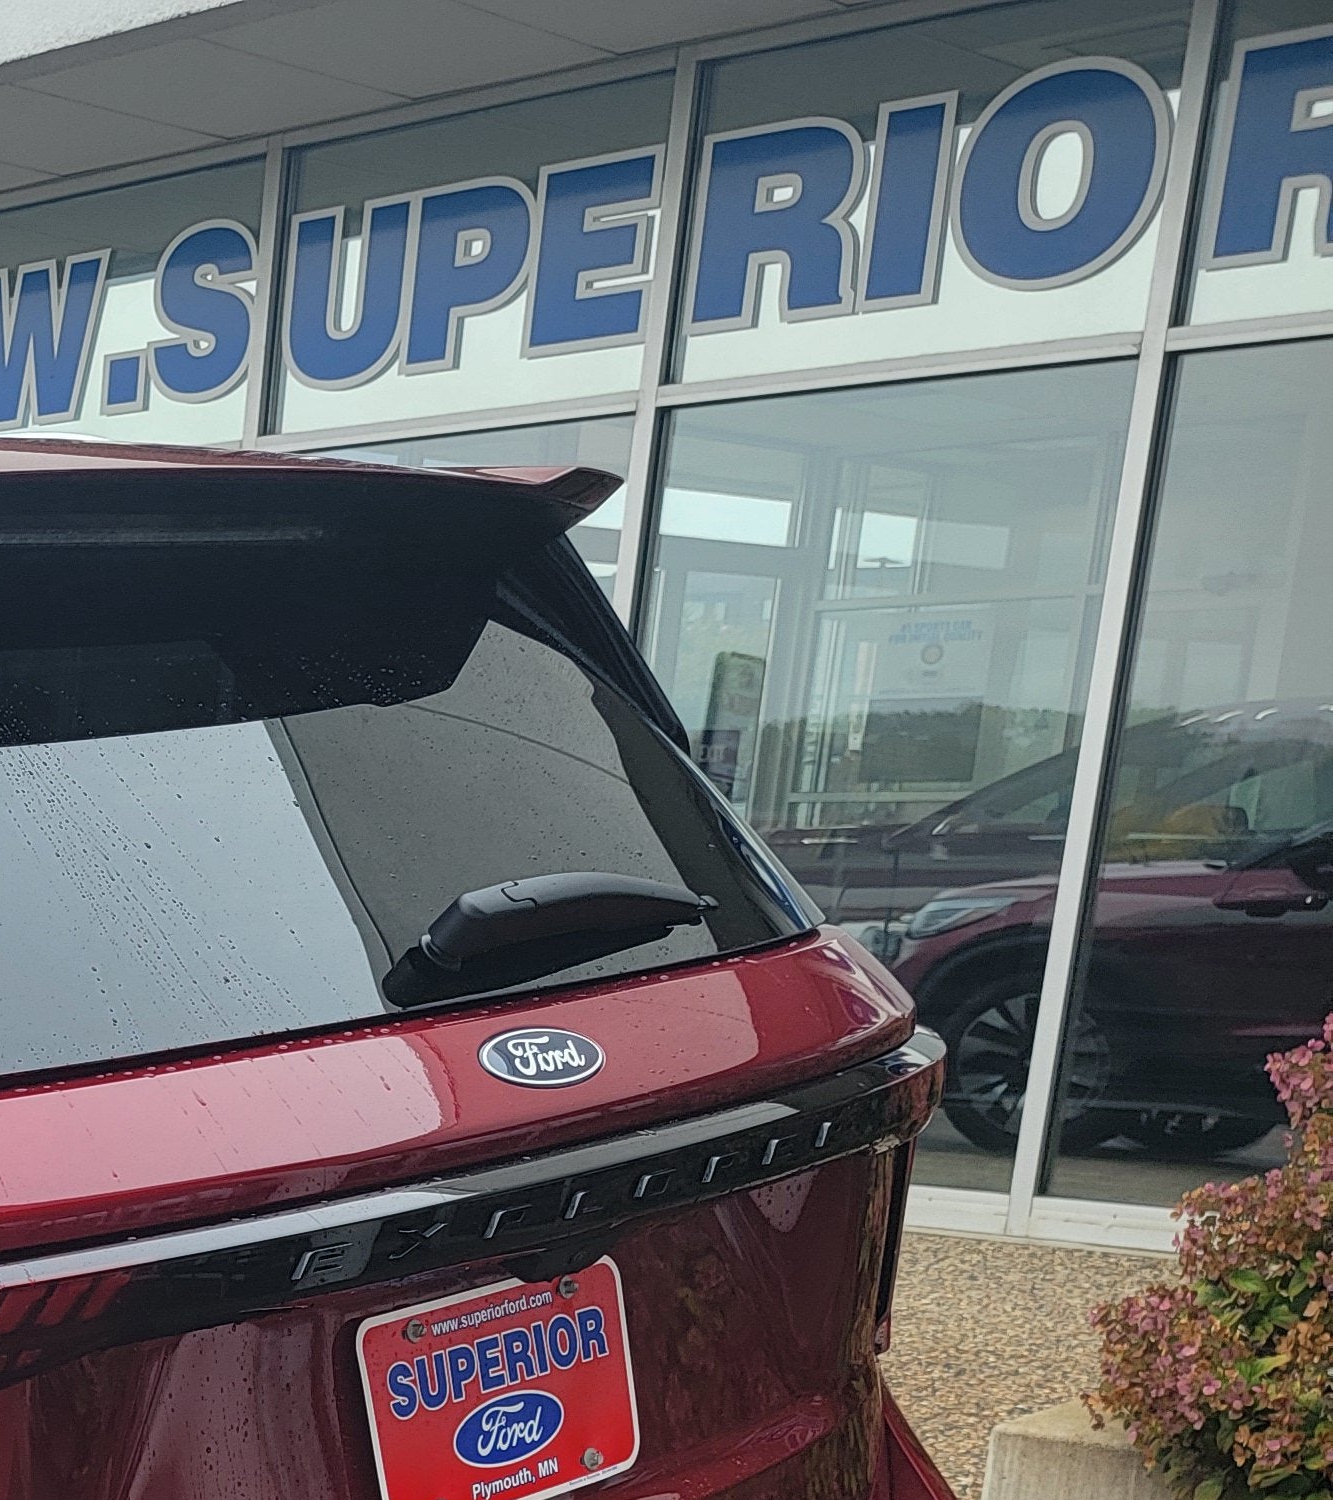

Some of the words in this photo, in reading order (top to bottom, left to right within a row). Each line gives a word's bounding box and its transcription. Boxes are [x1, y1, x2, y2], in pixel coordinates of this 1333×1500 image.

[507, 1035, 586, 1077] Ford
[430, 1290, 553, 1338] www.superiorford.com
[386, 1304, 610, 1421] SUPERIOR
[476, 1400, 544, 1457] Ford
[471, 1466, 536, 1500] Plymouth,
[537, 1456, 560, 1480] MN
